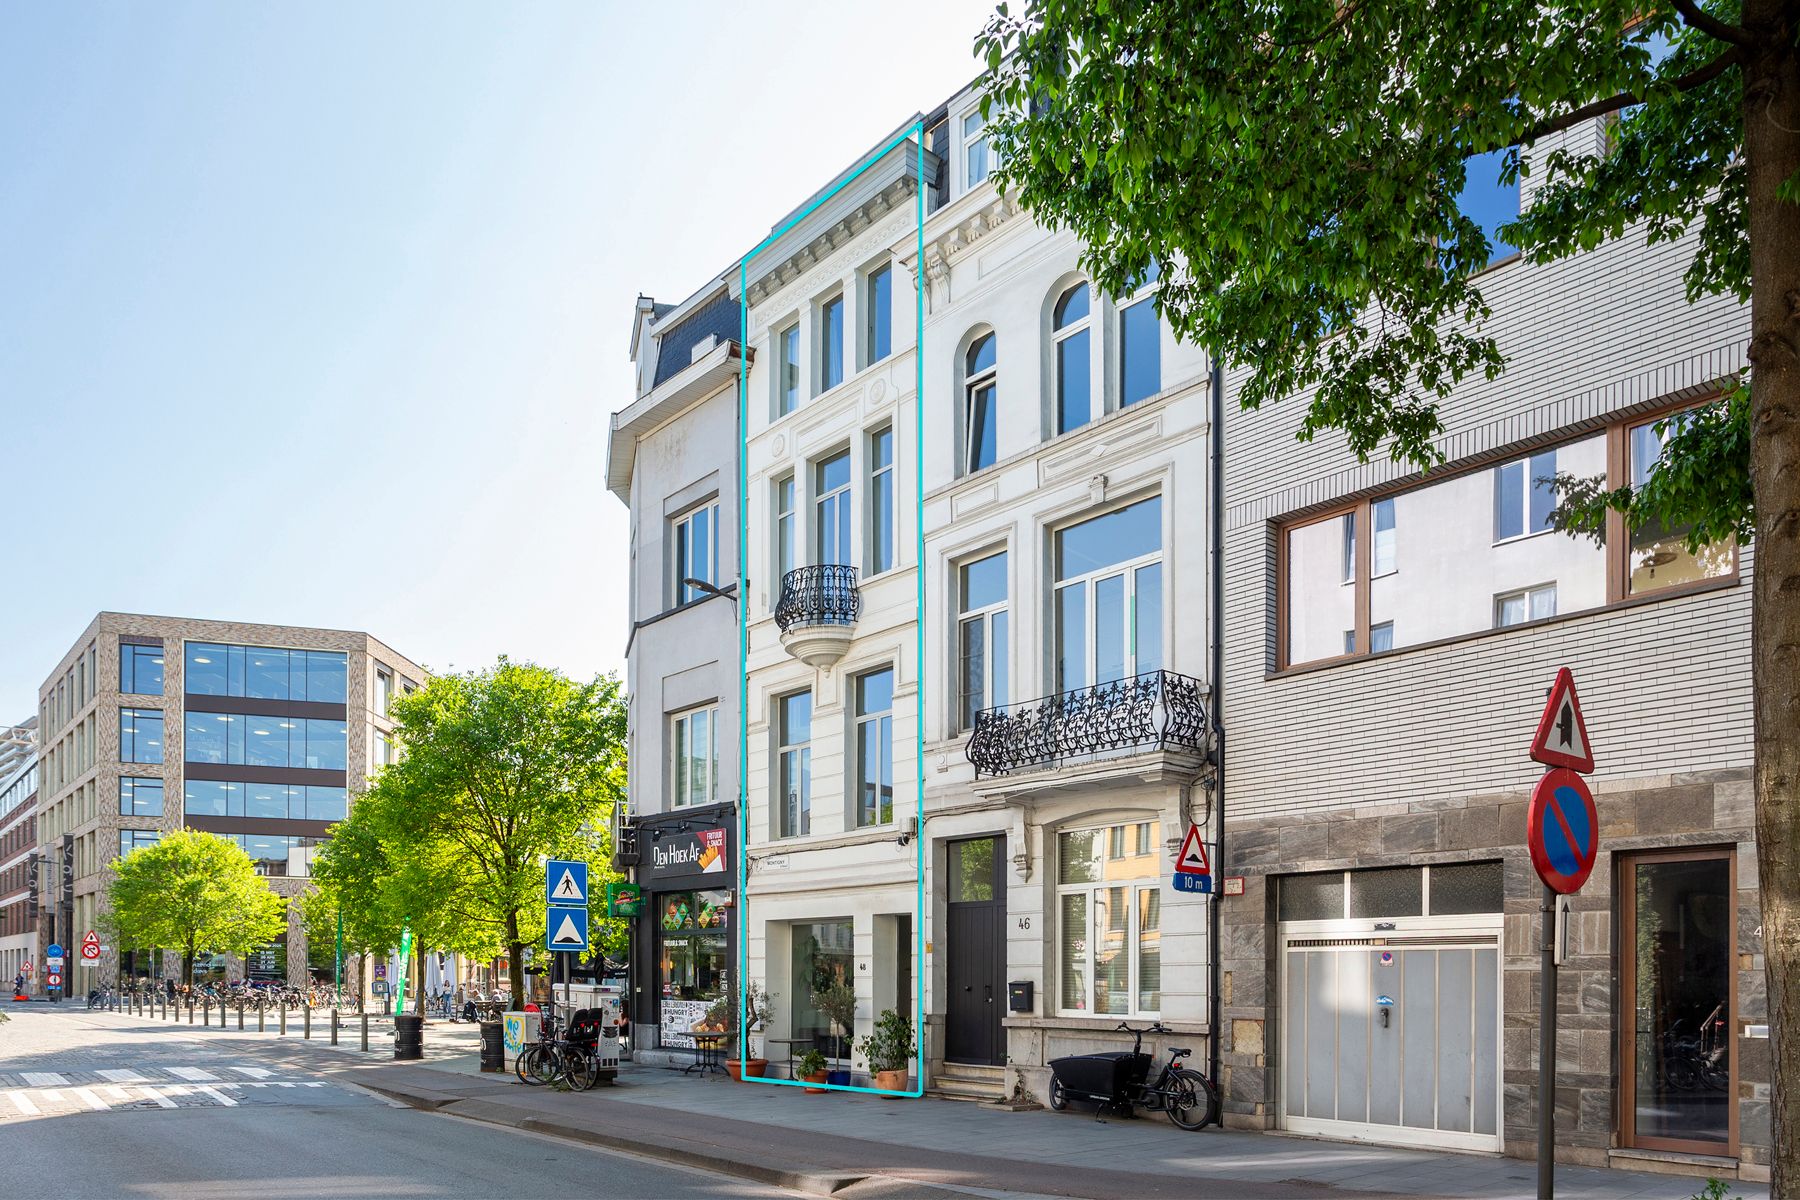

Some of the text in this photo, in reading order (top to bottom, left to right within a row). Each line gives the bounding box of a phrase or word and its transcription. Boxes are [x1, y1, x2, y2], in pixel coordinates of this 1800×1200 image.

[653, 841, 700, 865] DEN HOEK AF
[1184, 876, 1203, 889] 10 m
[1018, 917, 1030, 930] 46
